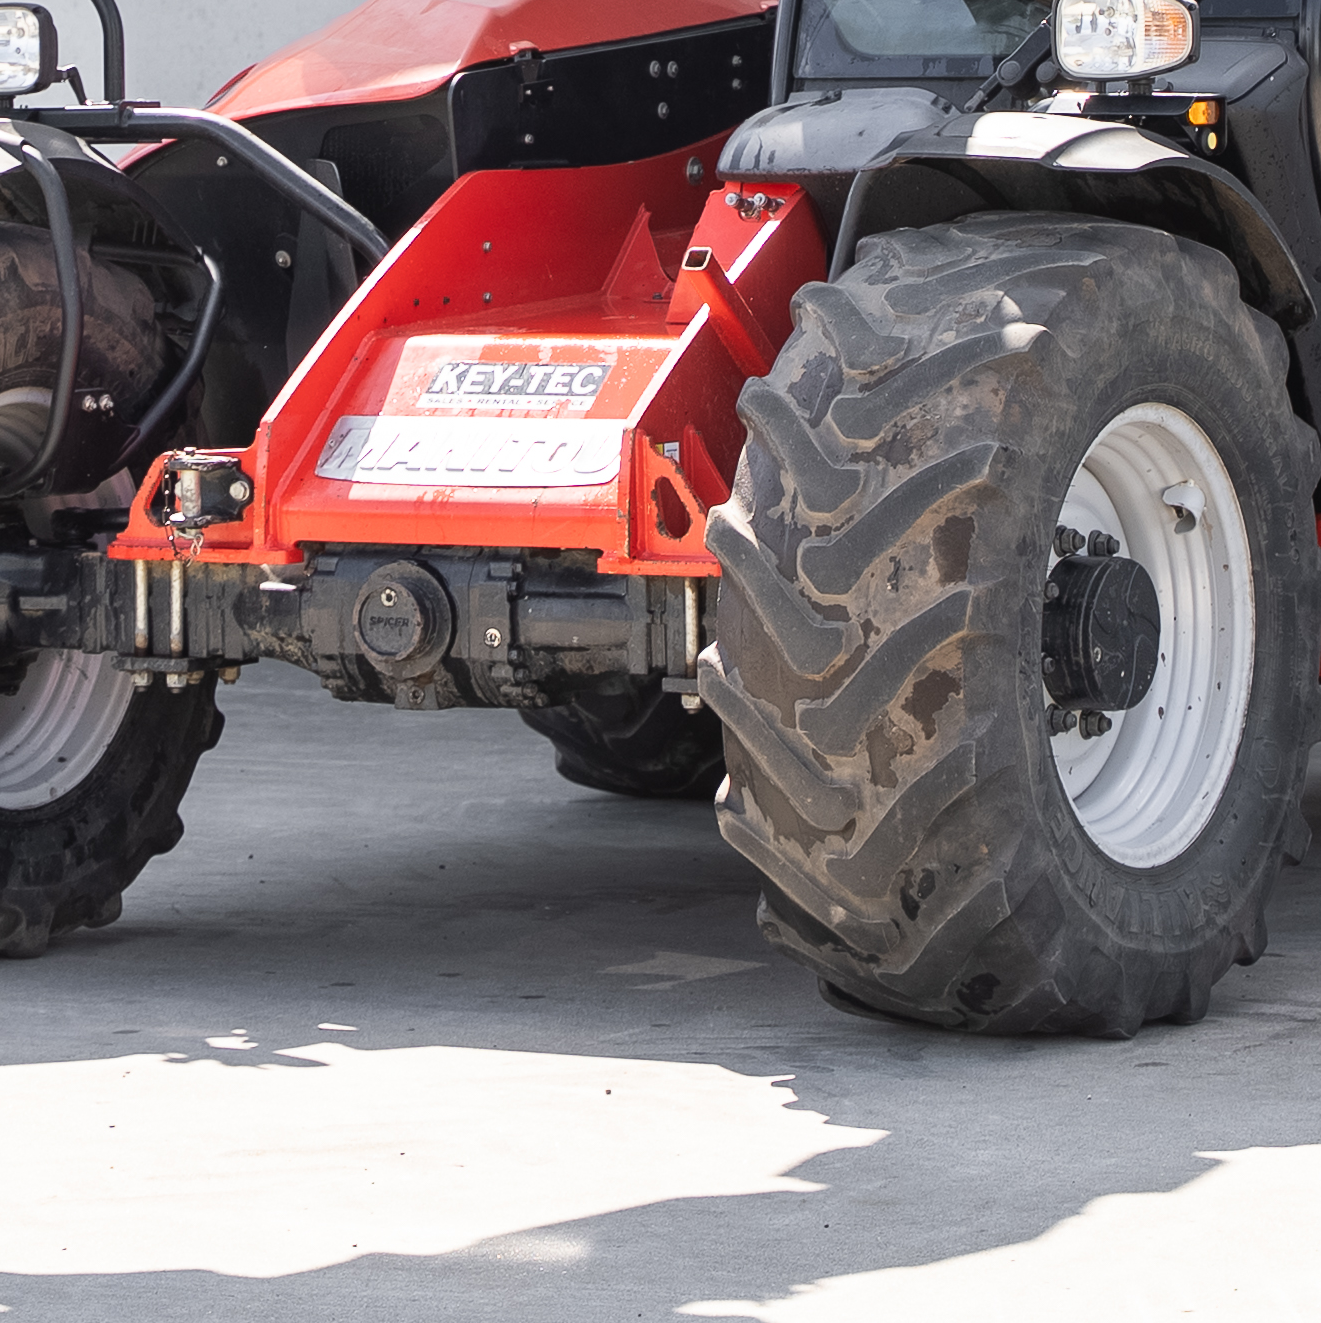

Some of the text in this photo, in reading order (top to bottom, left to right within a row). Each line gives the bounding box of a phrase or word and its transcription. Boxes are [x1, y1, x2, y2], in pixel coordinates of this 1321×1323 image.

[430, 364, 603, 395] KEY-TEC
[427, 397, 463, 405] SALES
[476, 397, 521, 406] RENTAL
[321, 428, 622, 475] MANITOU
[369, 616, 410, 627] SPICER
